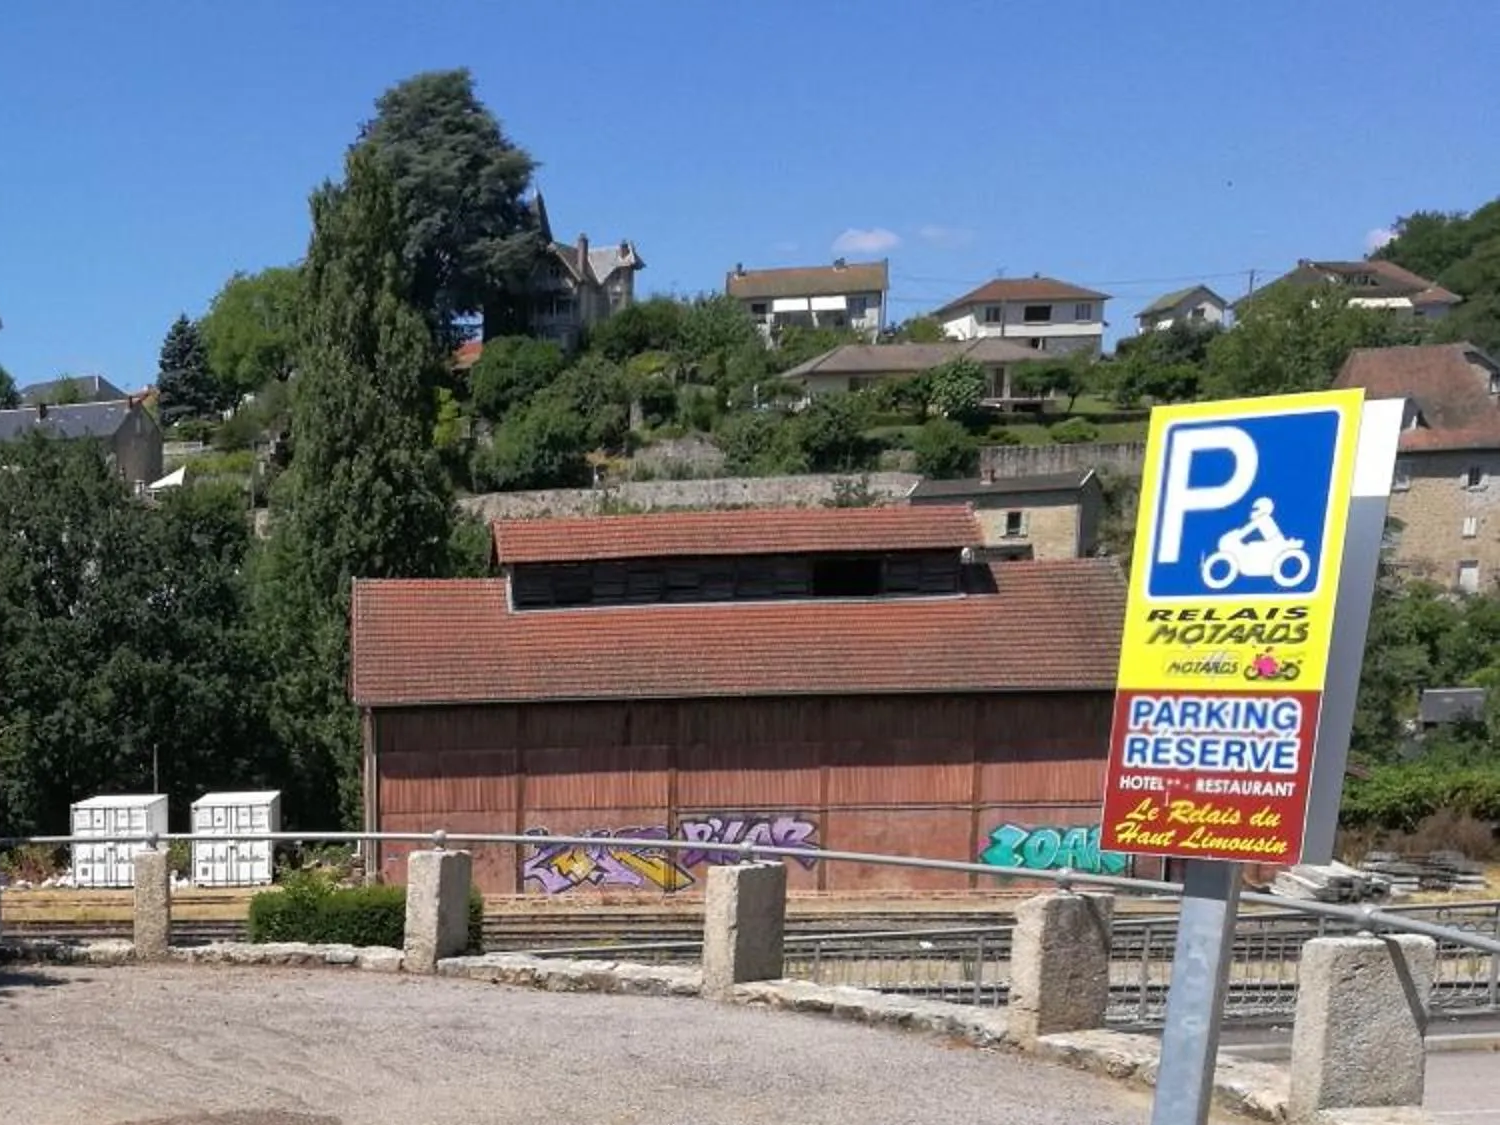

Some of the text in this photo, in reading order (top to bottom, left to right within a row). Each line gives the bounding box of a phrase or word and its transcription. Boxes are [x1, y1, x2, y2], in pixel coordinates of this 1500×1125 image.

[1157, 426, 1259, 563] P
[1147, 606, 1309, 621] RELAIS
[1145, 621, 1309, 645] MOTARDS
[1132, 699, 1298, 731] PARKING
[1125, 730, 1297, 770] RÉSERVÉ
[1195, 776, 1296, 797] RESTAURANT
[1126, 797, 1281, 828] Le Relais du
[1115, 821, 1288, 853] Haut Limousin
